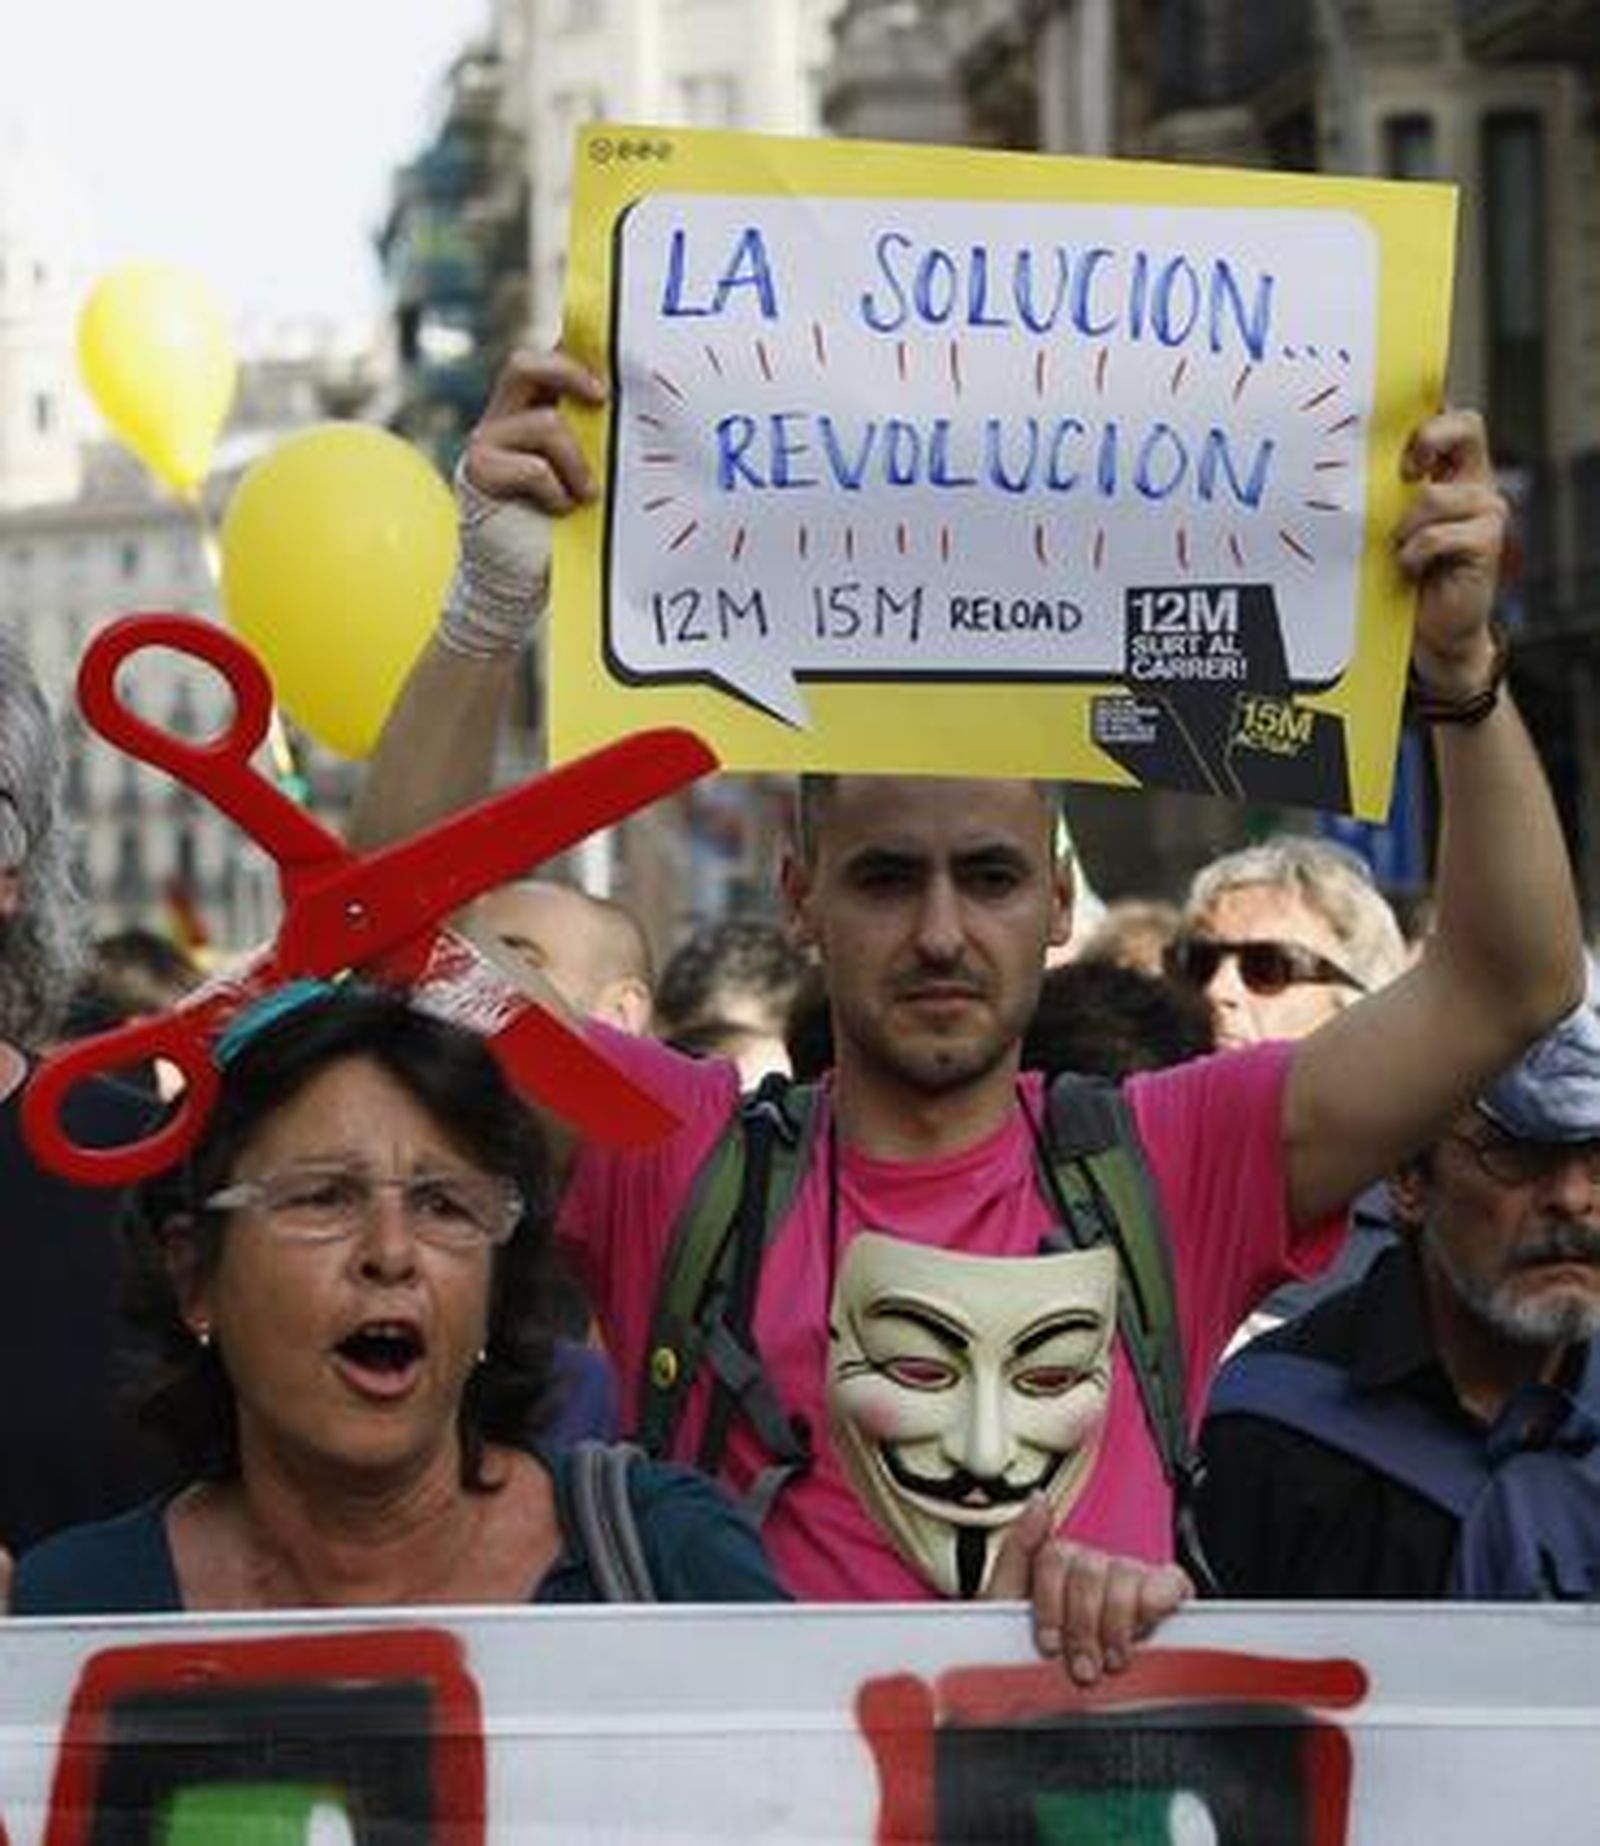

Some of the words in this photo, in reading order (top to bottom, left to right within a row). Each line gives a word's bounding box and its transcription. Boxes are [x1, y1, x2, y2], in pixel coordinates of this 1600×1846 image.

[662, 226, 778, 319] LA
[716, 412, 1275, 508] REVOLUCION
[652, 586, 769, 645] 12M
[813, 583, 923, 643] 15M
[949, 596, 1083, 634] RELOAD
[1131, 588, 1240, 633] 12M
[1131, 634, 1203, 656] SURT
[1209, 634, 1243, 656] AL
[1131, 656, 1248, 680] CARRER!
[1243, 701, 1315, 743] 15M
